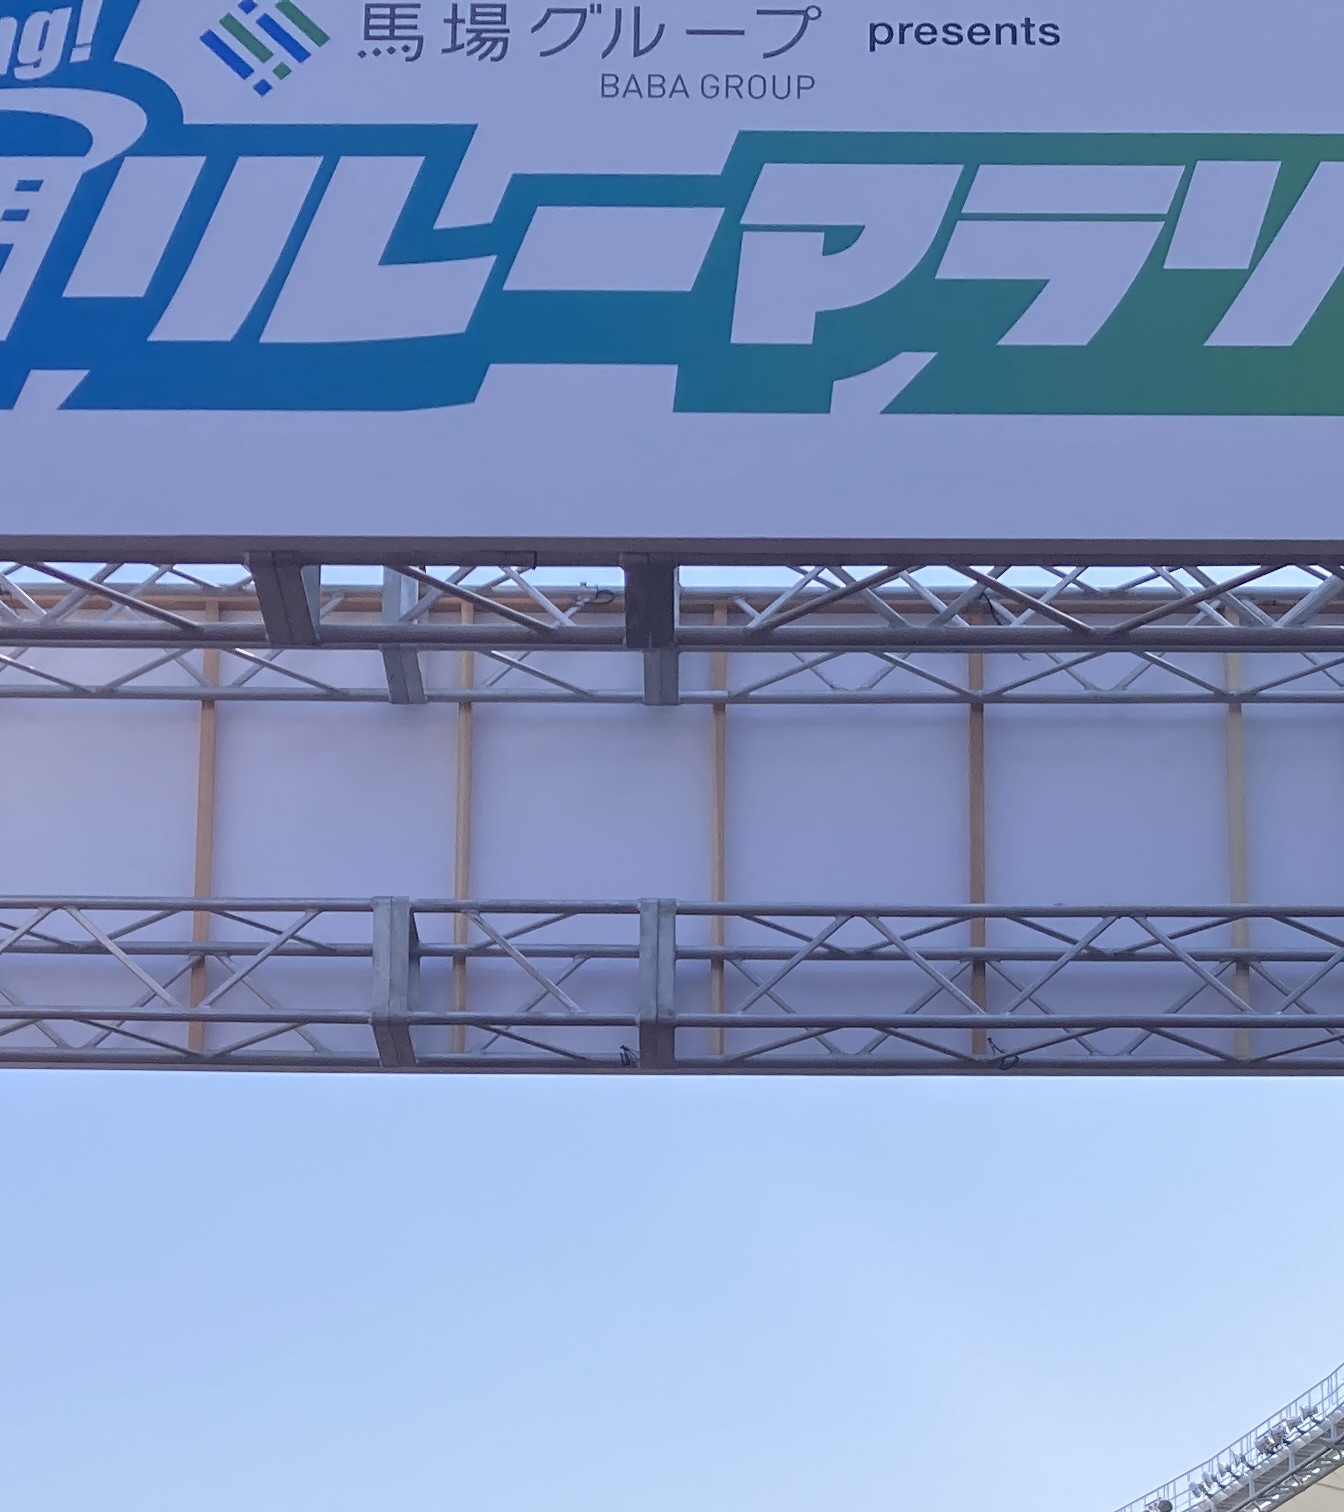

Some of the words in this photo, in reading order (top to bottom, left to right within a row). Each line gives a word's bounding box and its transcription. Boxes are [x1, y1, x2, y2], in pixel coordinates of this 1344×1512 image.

[357, 2, 823, 63] 馬場グループ
[869, 16, 1062, 52] presents
[599, 73, 690, 99] BABA
[700, 74, 816, 100] GROUP
